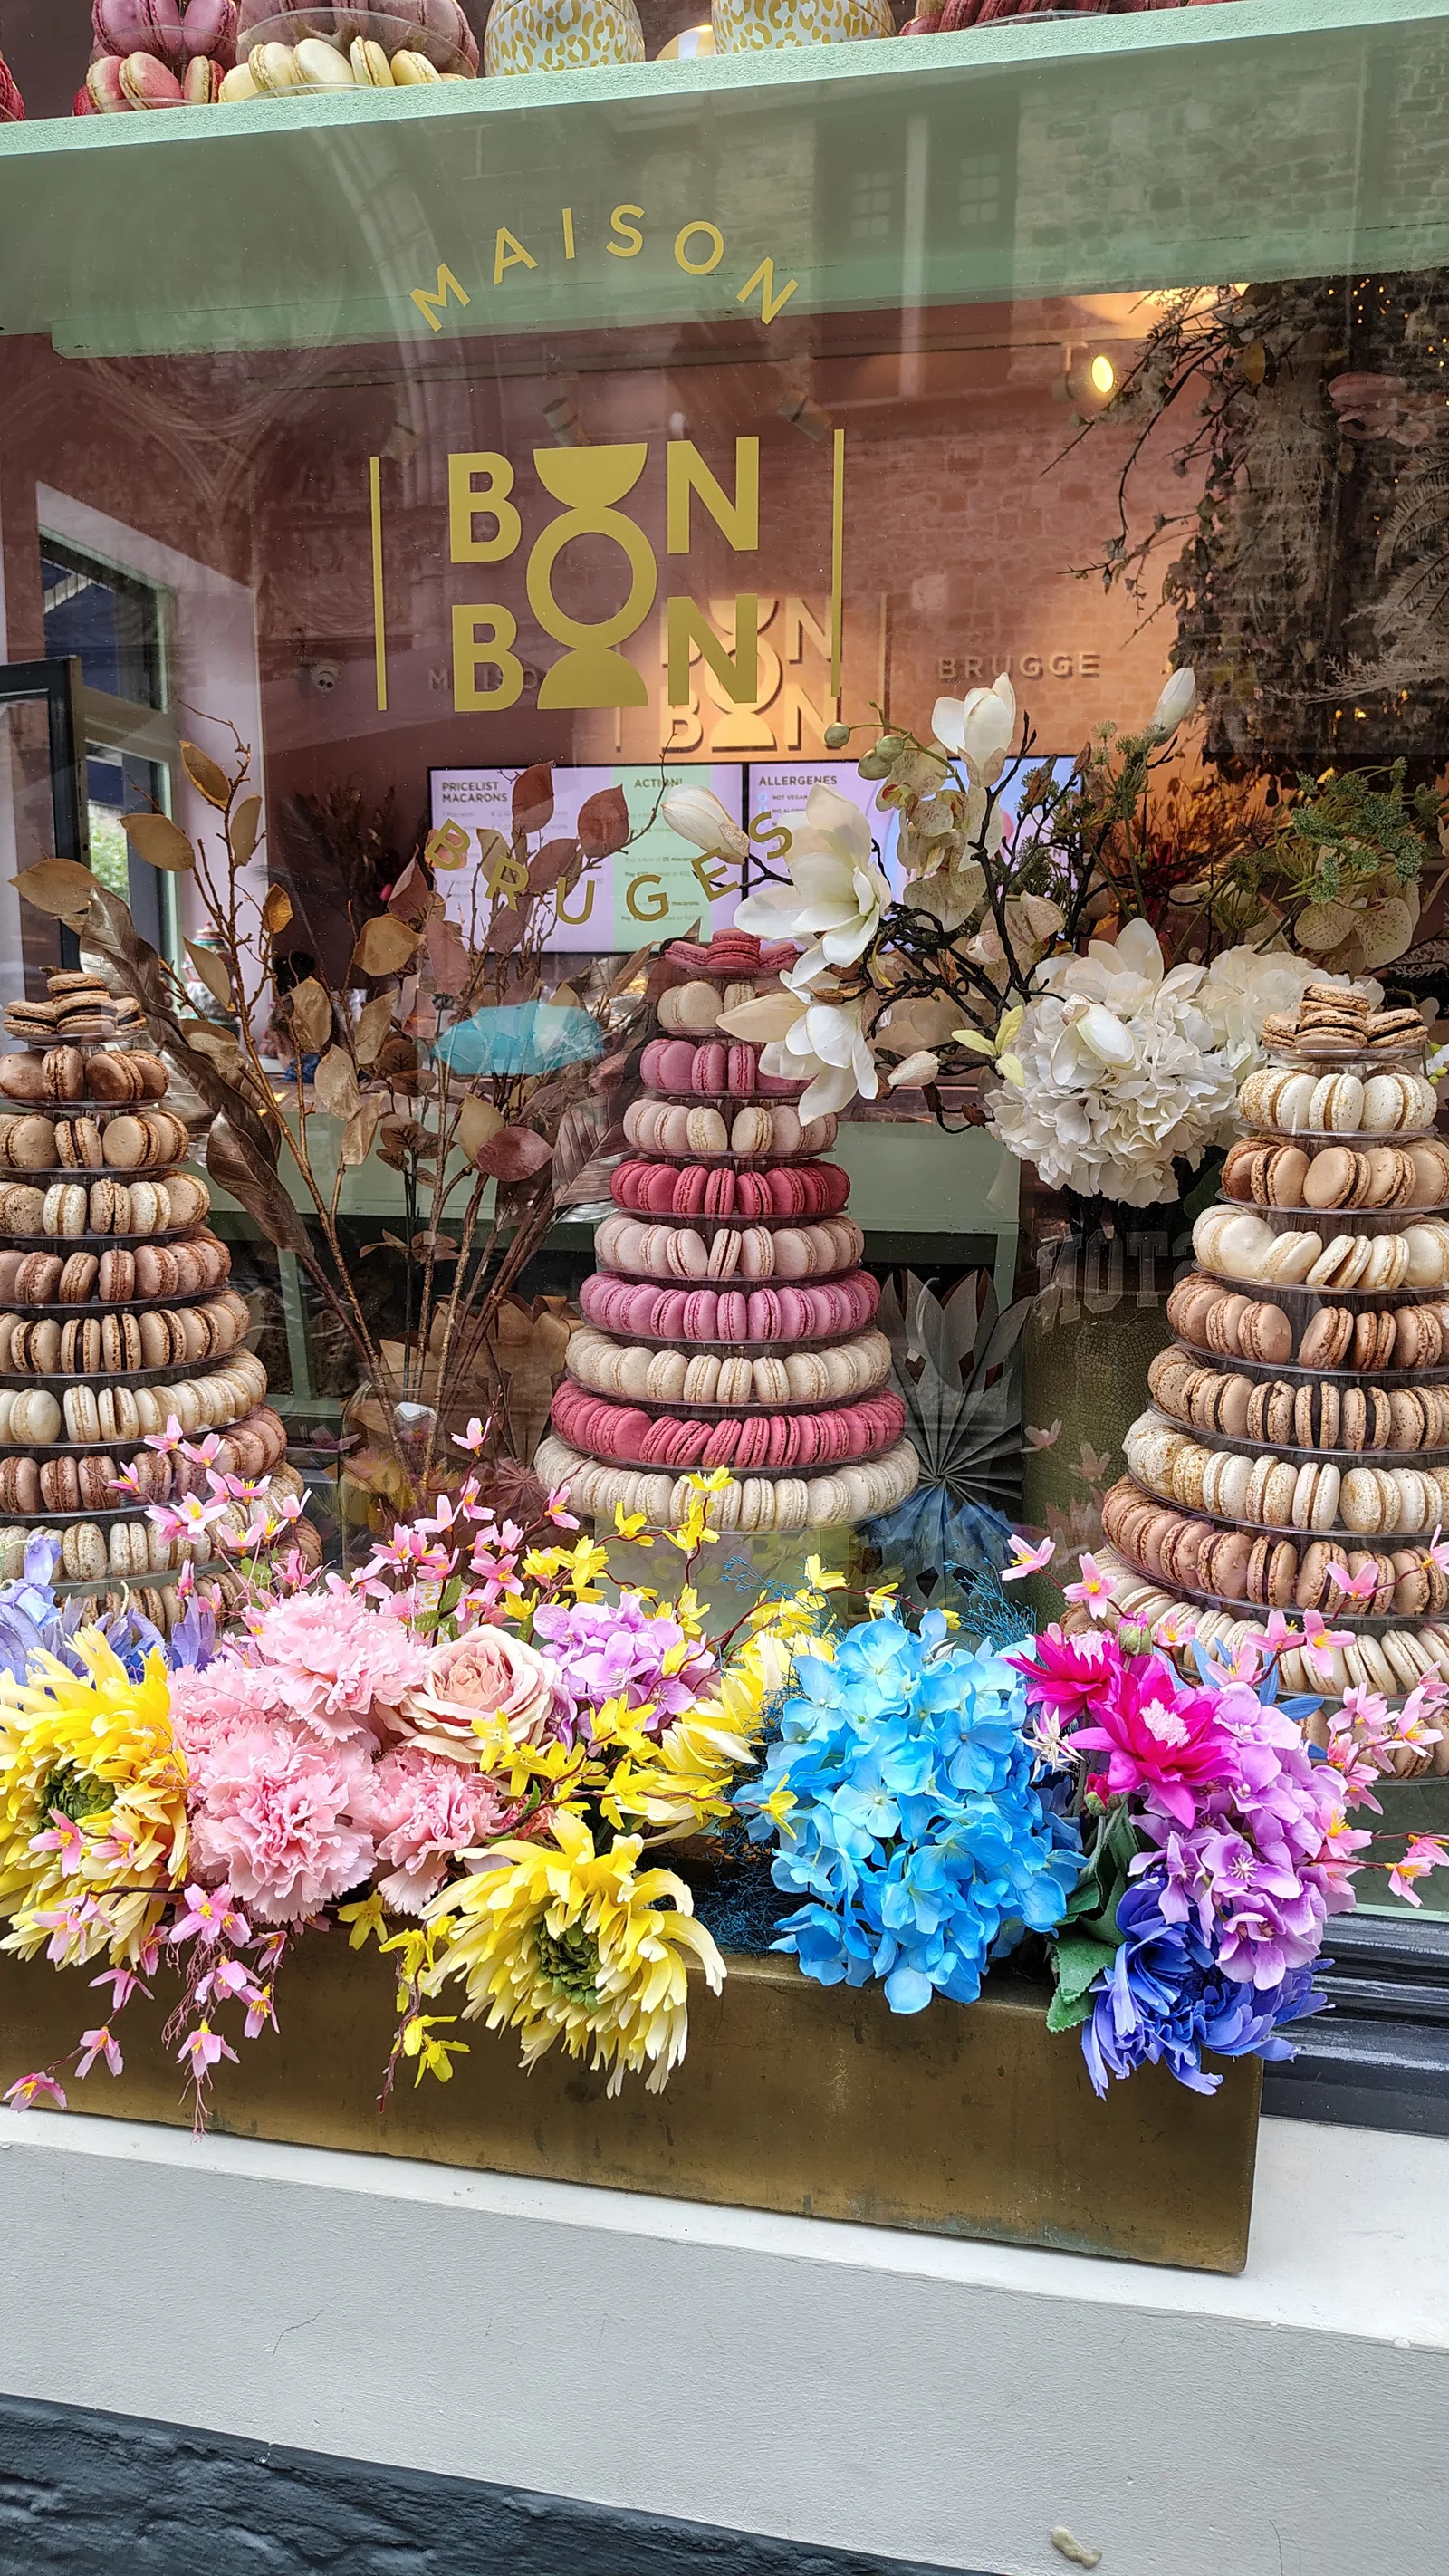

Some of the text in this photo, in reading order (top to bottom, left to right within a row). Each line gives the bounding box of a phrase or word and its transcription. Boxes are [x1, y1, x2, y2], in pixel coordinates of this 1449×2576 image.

[409, 204, 799, 332] MAISON
[937, 650, 1101, 681] BRUGGE
[441, 781, 500, 792] PRICELIST
[758, 775, 838, 786] ALLERGENES
[441, 793, 508, 803] MACARONS
[424, 810, 793, 925] BRUGES
